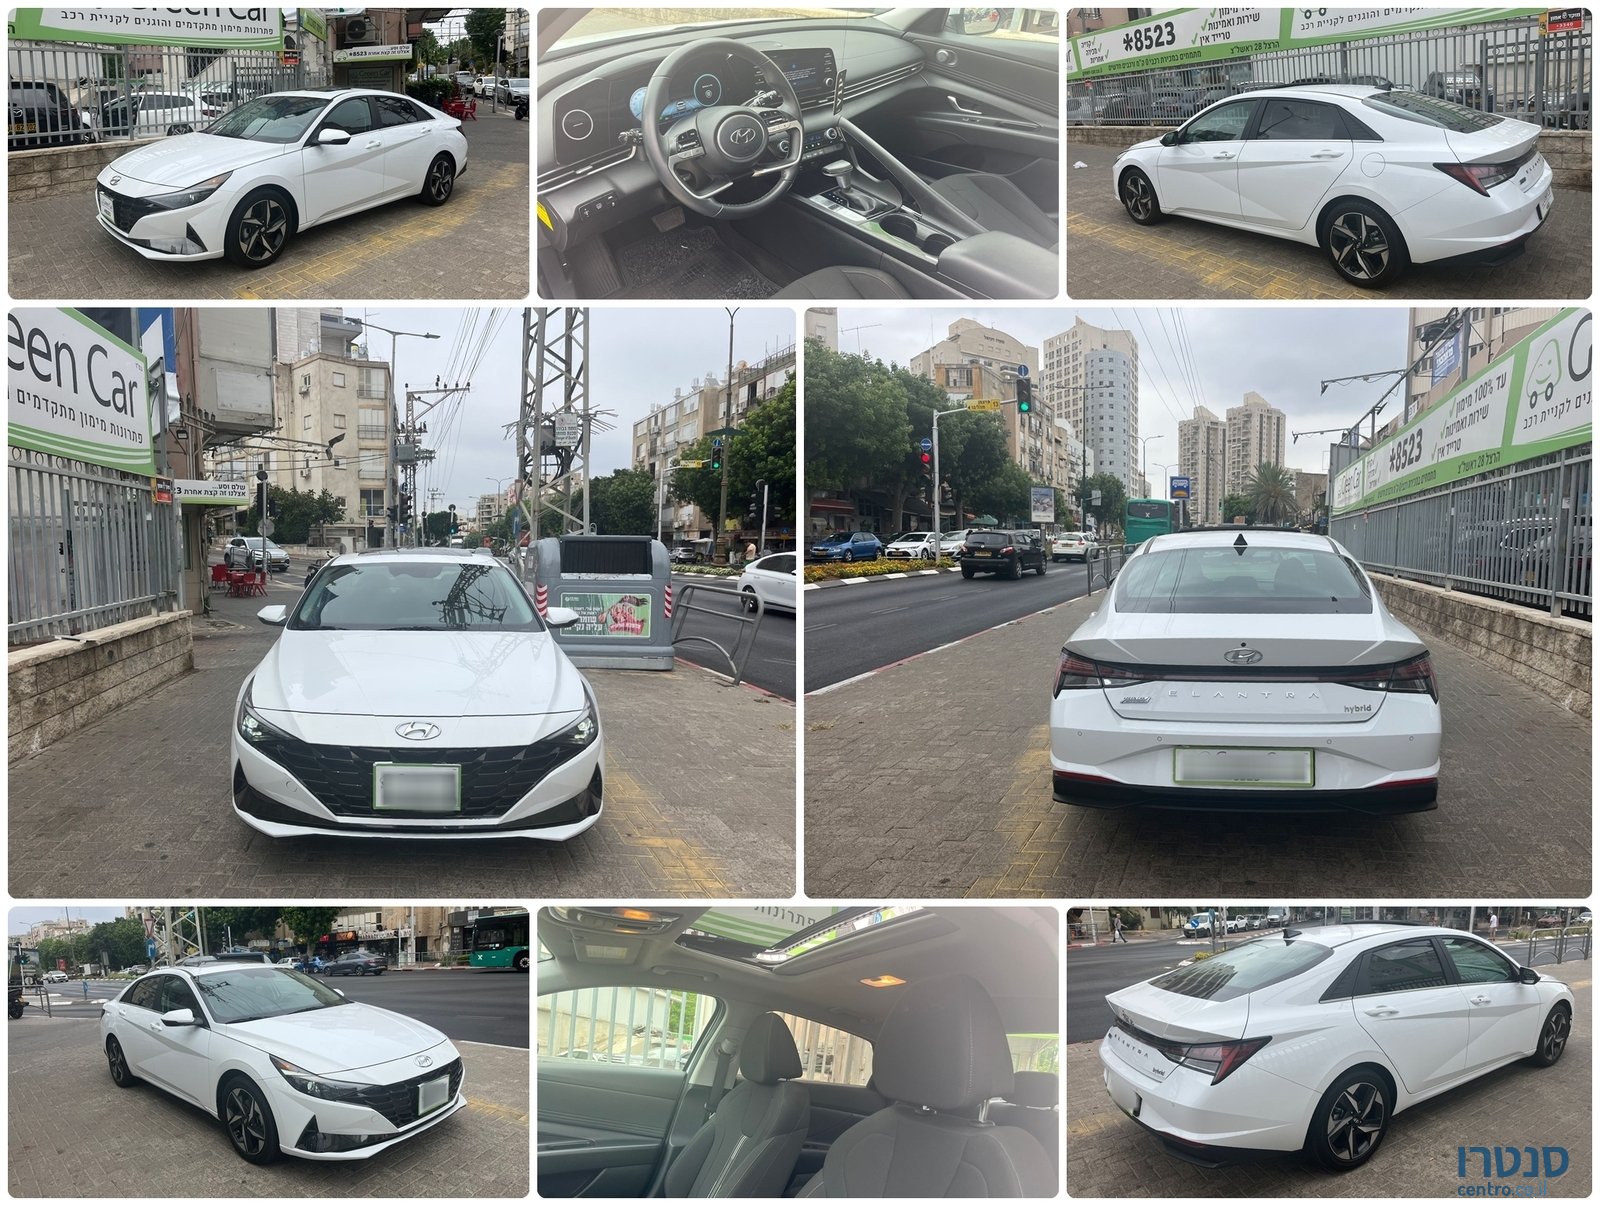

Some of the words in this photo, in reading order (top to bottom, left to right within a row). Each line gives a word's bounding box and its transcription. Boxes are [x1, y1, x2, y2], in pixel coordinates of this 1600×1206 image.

[61, 10, 84, 20] רכב
[90, 12, 129, 25] לקניית
[1236, 12, 1260, 25] שירות
[1317, 15, 1344, 28] לקניית
[1347, 9, 1380, 22] והוגנים
[134, 17, 171, 27] והוגנים
[175, 20, 217, 31] מתקדמים
[220, 24, 241, 33] מימון
[1208, 18, 1235, 31] ואמינות
[1300, 21, 1314, 30] רכב
[244, 26, 274, 35] פתרונות
[1211, 31, 1231, 42] טרייד
[1200, 35, 1210, 46] אין
[1254, 42, 1262, 50] 28
[1264, 41, 1280, 49] הרצל
[87, 344, 138, 418] Car
[1496, 371, 1507, 390] עד
[1474, 379, 1494, 404] 100%
[17, 388, 76, 421] מתקדמים
[1456, 393, 1473, 418] מימון
[1540, 398, 1571, 424] לקניית
[80, 411, 107, 432] מימון
[1468, 403, 1489, 427] שירות
[1445, 415, 1468, 439] ואמינות
[1523, 414, 1538, 430] רכב
[110, 422, 143, 444] פתרונות
[1446, 438, 1461, 455] טרייד
[1437, 445, 1445, 464] אין
[1477, 455, 1485, 467] 28
[1486, 451, 1501, 465] הרצל
[1168, 690, 1320, 699] ELANTRA
[1344, 704, 1372, 714] hybrid
